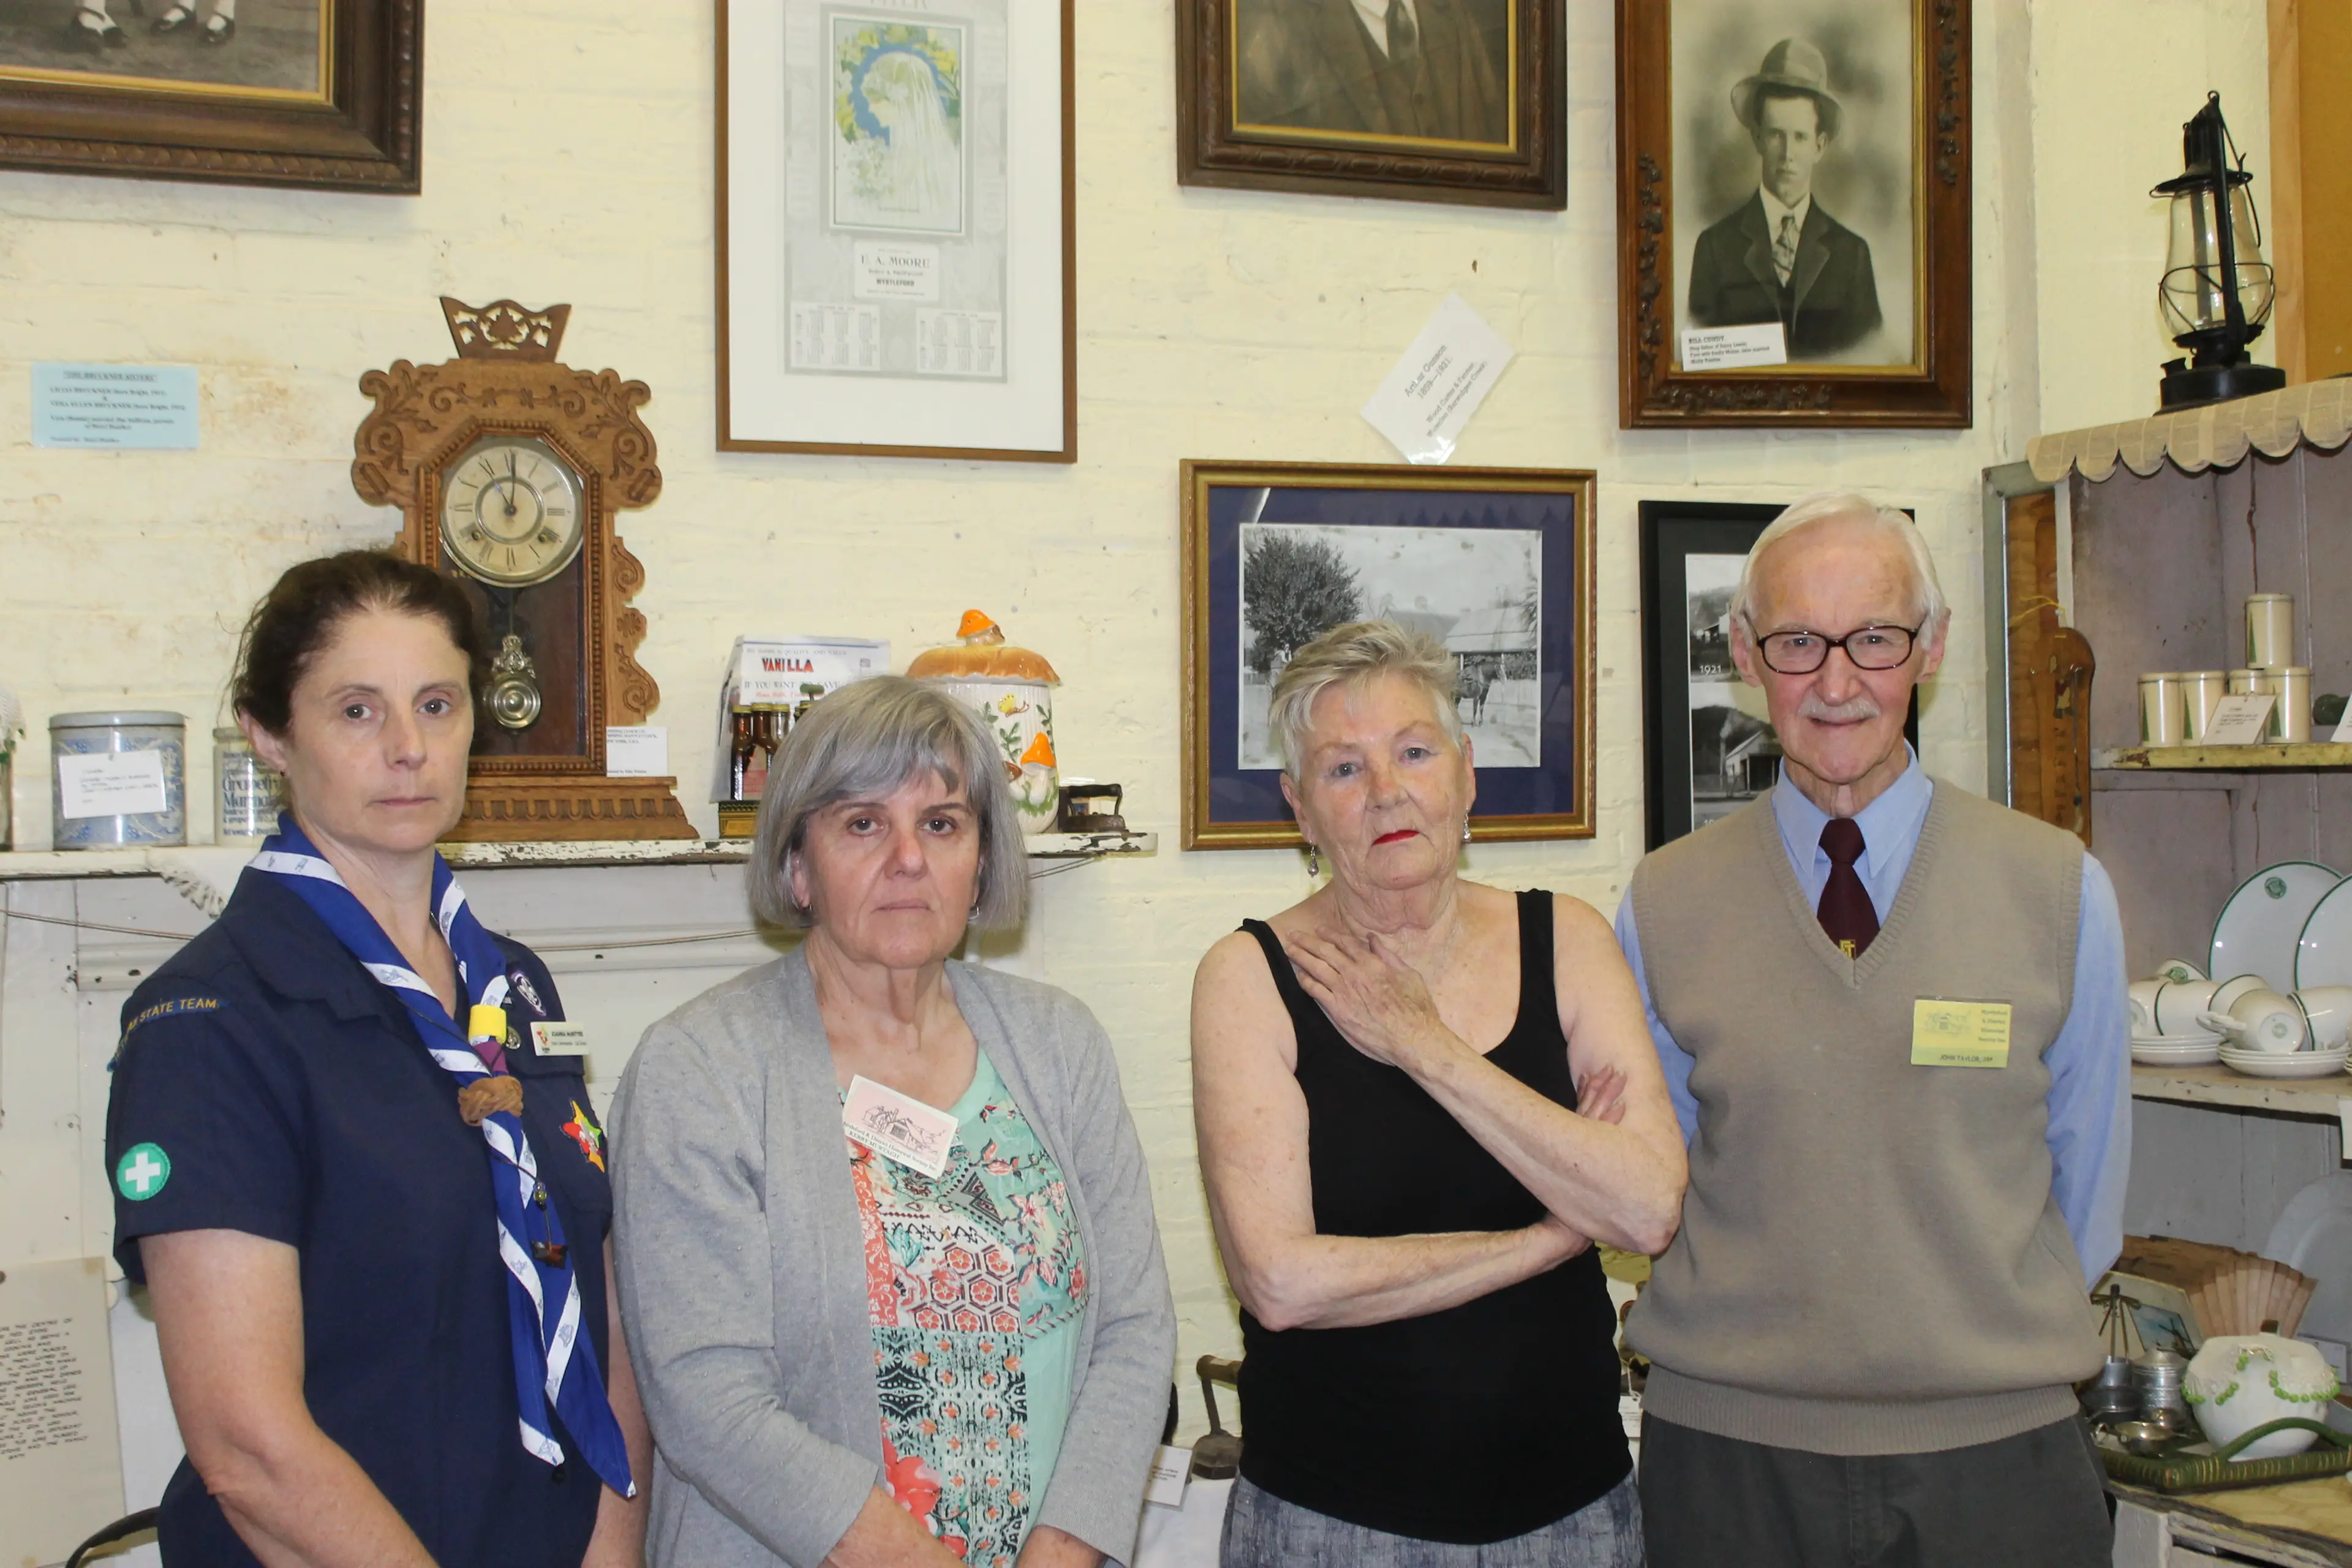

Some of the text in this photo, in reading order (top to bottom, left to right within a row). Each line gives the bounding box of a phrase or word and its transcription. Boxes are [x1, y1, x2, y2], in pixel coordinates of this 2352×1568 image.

[889, 257, 930, 268] MOORE
[762, 657, 814, 672] VANILLA
[1699, 665, 1721, 676] 1921
[140, 998, 217, 1022] STATE TEAM
[843, 1121, 867, 1137] yrtleford
[871, 1134, 888, 1146] District
[889, 1142, 911, 1158] Historical
[911, 1155, 929, 1168] Society
[850, 1131, 900, 1159] KERRY MURTAGH
